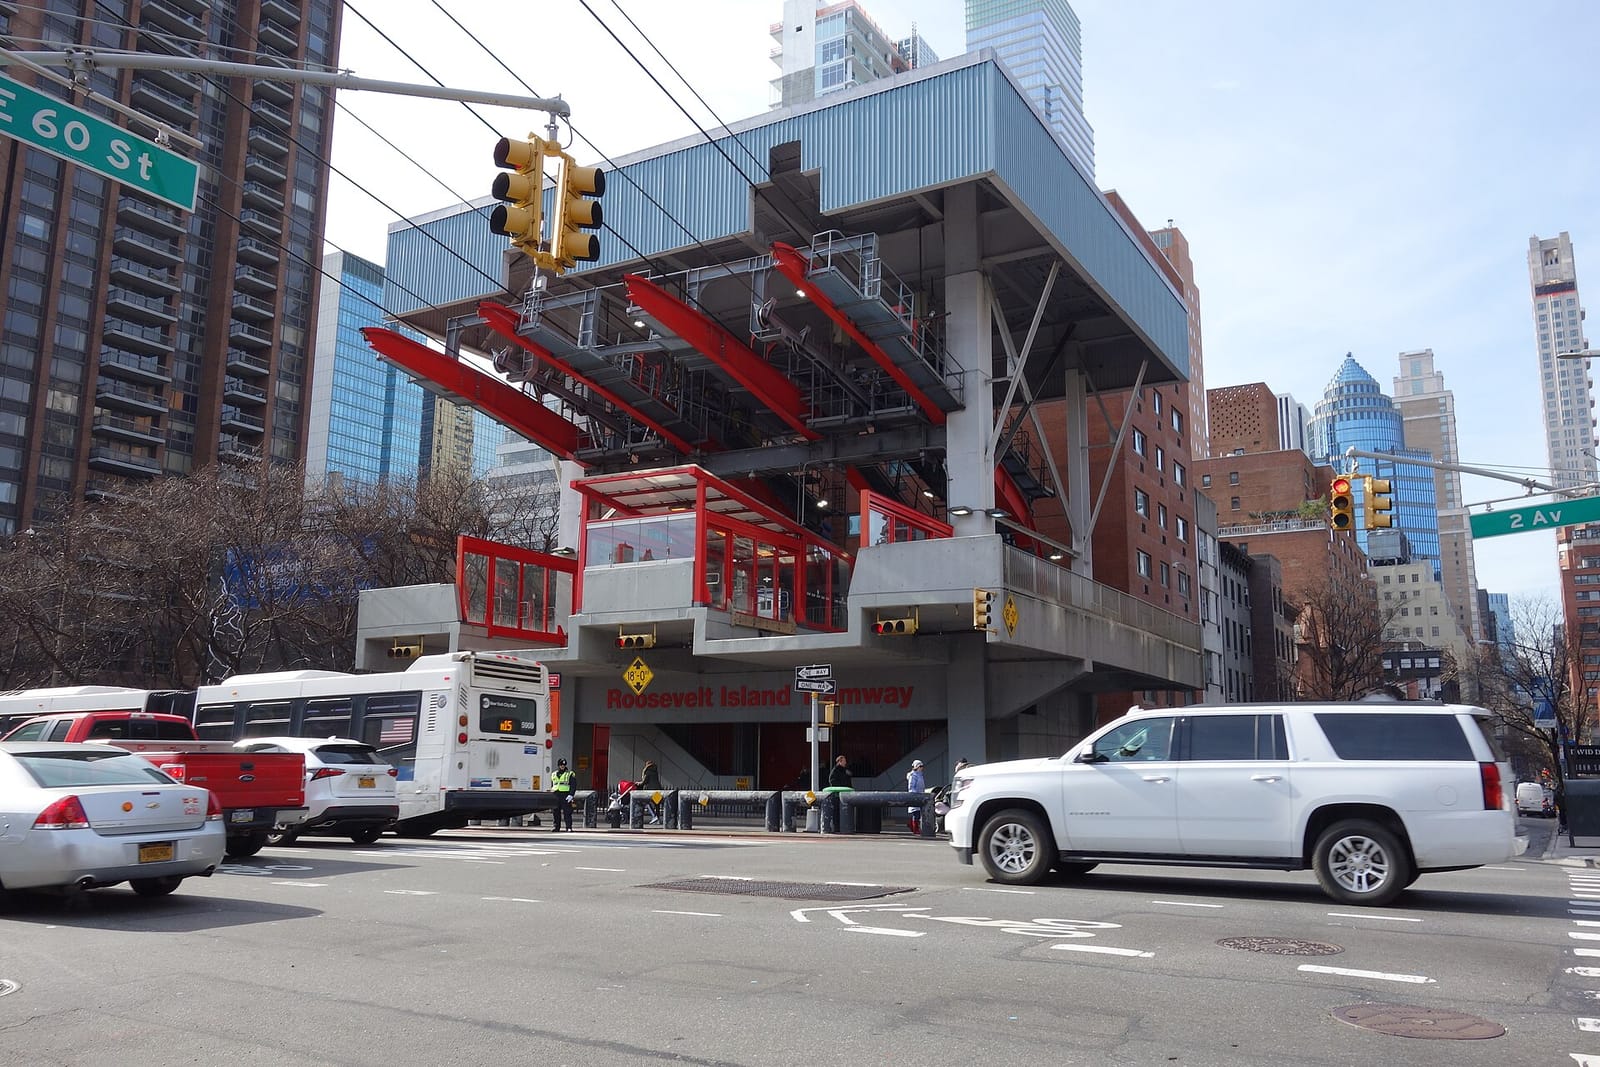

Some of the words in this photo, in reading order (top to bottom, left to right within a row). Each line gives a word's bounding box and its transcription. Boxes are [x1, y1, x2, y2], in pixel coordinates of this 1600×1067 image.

[0, 88, 16, 123] E
[32, 109, 90, 151] 60
[106, 139, 153, 181] St
[1509, 513, 1524, 528] 2
[1532, 510, 1561, 526] Av
[606, 686, 714, 710] Roosevelt
[720, 684, 791, 707] Island
